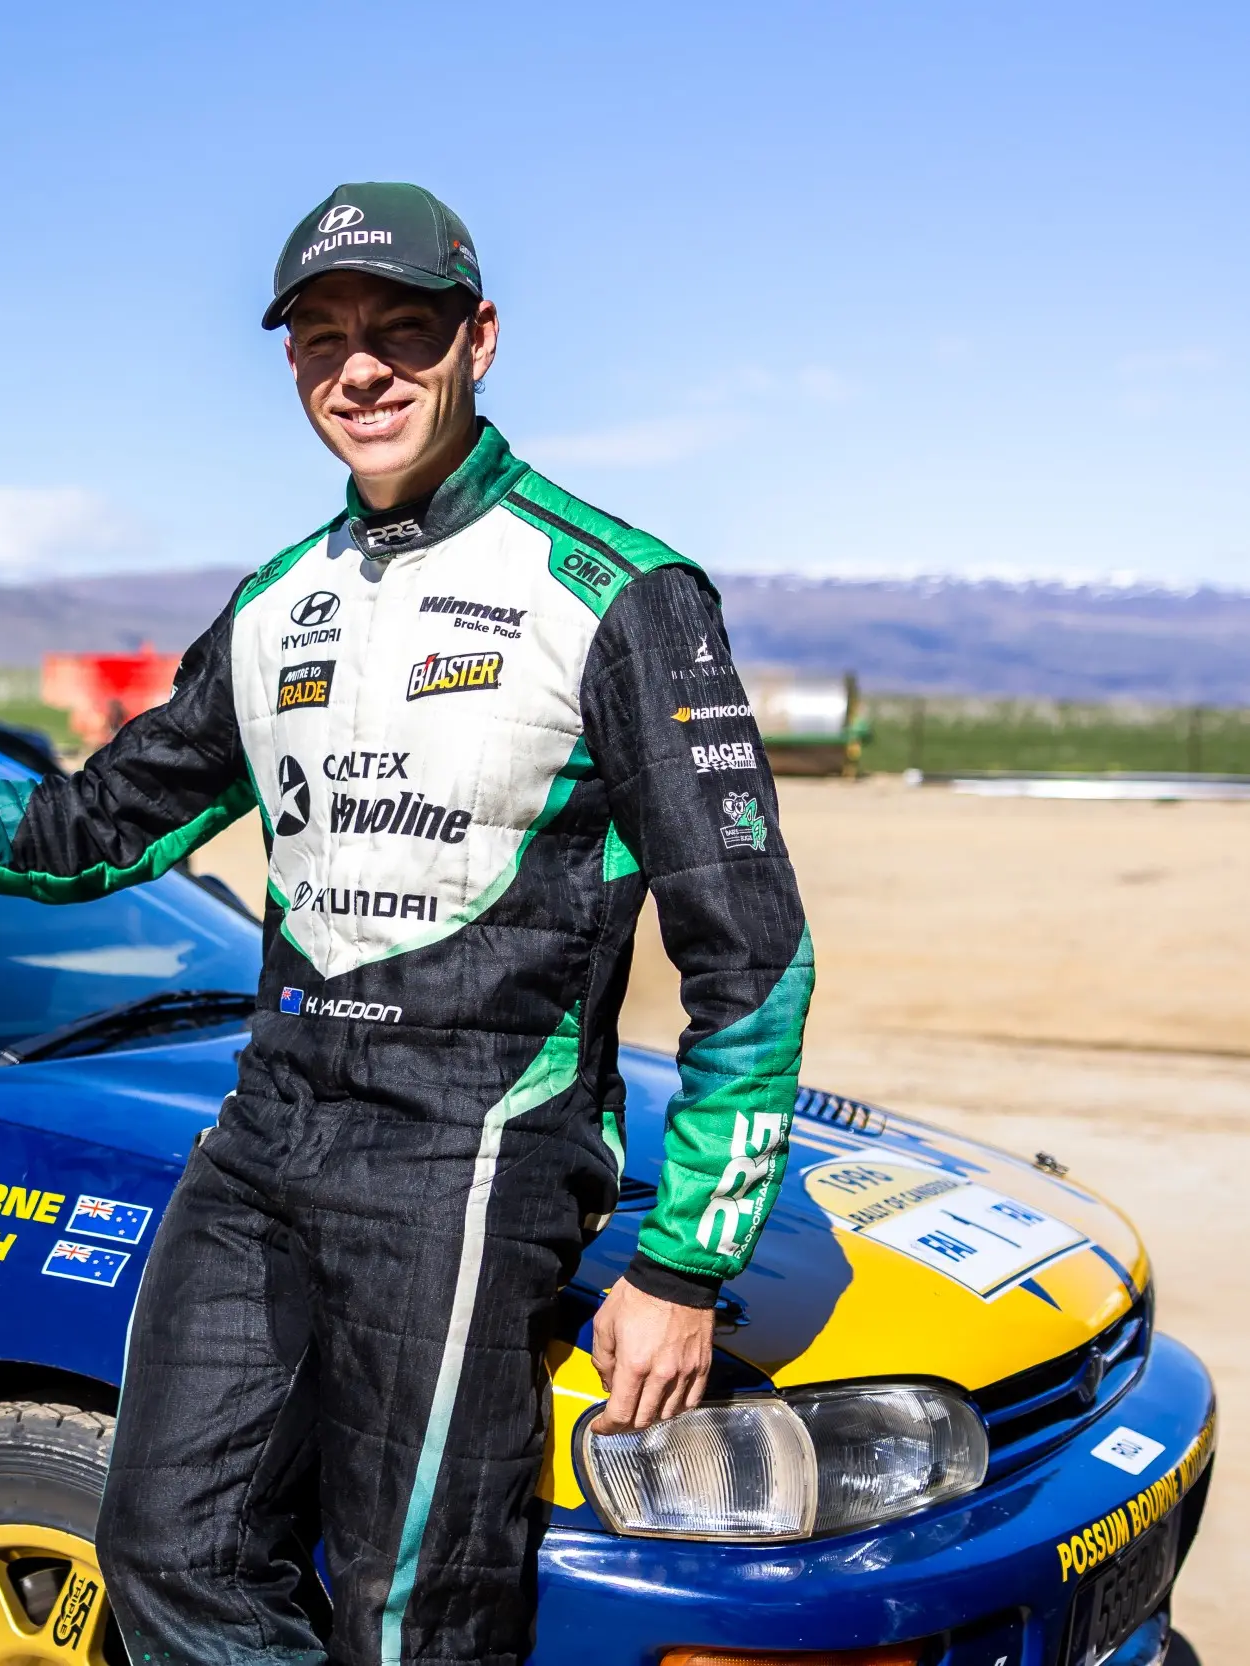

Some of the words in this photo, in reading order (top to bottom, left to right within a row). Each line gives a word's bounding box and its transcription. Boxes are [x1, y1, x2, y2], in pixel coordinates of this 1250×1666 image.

[301, 231, 392, 265] HYUNDAI
[366, 519, 423, 548] PRG
[562, 552, 616, 589] OMP
[281, 628, 342, 651] HYUNDAI
[454, 617, 490, 633] Brake
[493, 625, 522, 639] Pads
[284, 667, 310, 682] MITRE
[310, 666, 321, 678] 10
[701, 665, 734, 677] NEVI
[323, 751, 411, 781] CALTEX
[691, 742, 755, 765] RACER
[311, 887, 438, 922] HUNDAI
[696, 1110, 783, 1258] PRG
[818, 1166, 894, 1195] 1996
[1056, 1508, 1130, 1583] POSSUM
[1127, 1468, 1180, 1538] BOURNE
[59, 1577, 86, 1636] TRIPLE
